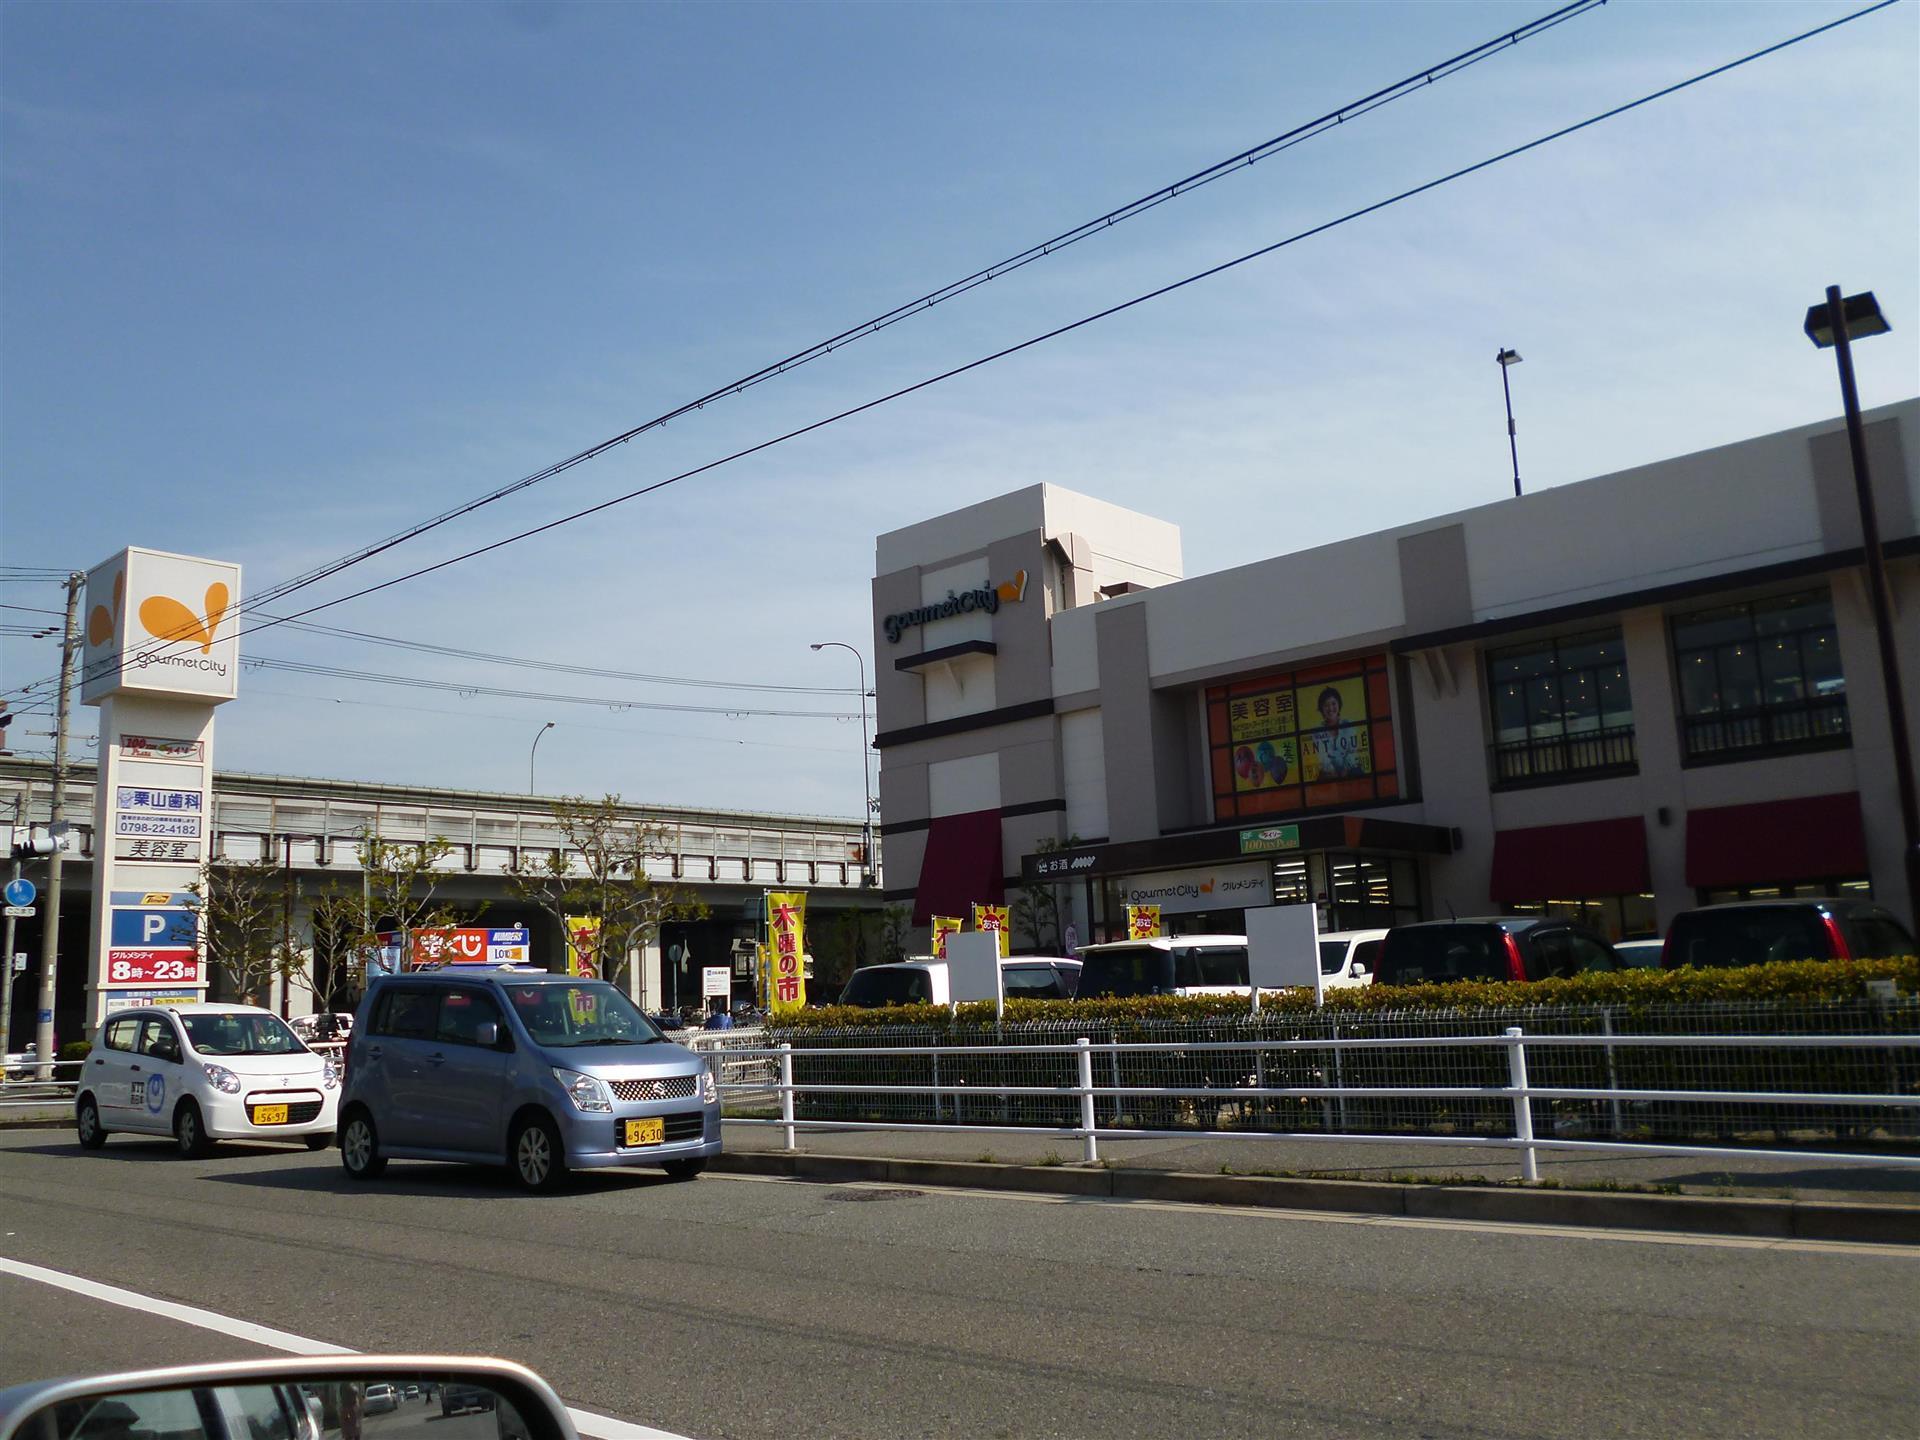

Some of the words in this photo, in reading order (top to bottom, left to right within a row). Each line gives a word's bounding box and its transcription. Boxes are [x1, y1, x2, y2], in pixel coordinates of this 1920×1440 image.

[1231, 695, 1293, 721] 美容室
[134, 790, 199, 809] 栗山歯科
[120, 822, 196, 835] 0798-22-4182
[129, 841, 188, 858] 美容室
[1222, 879, 1265, 892] グルメシティ
[143, 914, 166, 942] P
[772, 903, 802, 1002] 木曜の市
